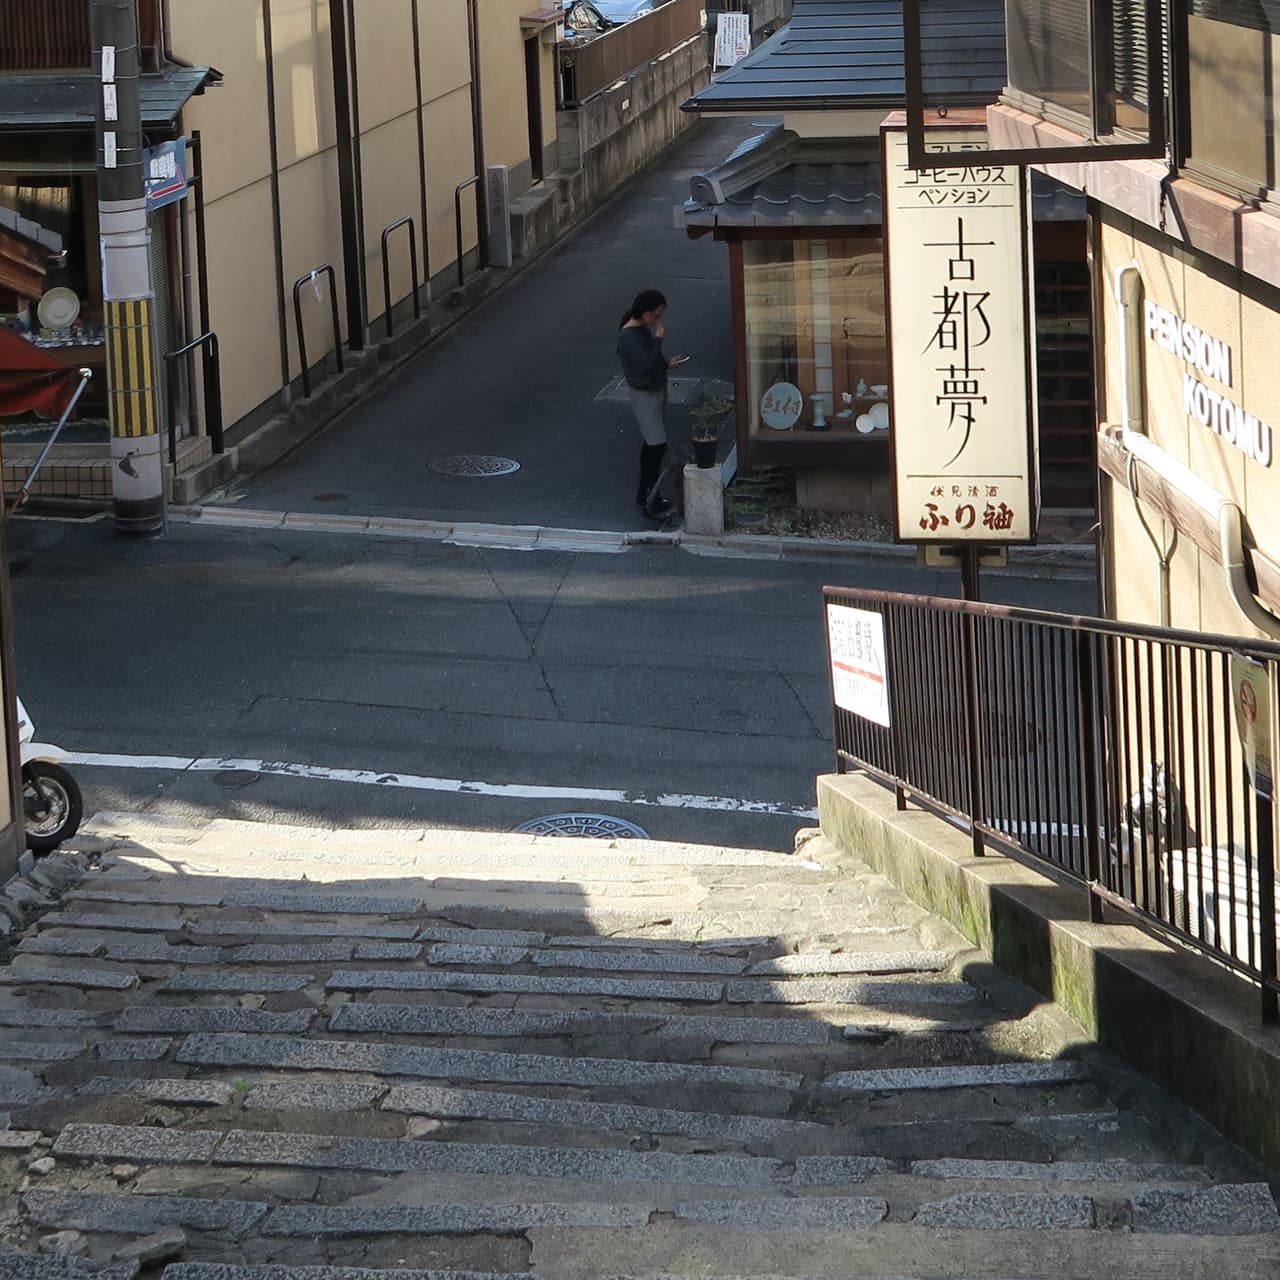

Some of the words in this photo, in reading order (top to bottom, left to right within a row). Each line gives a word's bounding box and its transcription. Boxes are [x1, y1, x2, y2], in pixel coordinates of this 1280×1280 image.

[904, 166, 1006, 185] コーヒーハウス
[918, 188, 990, 205] ペンション
[920, 216, 996, 470] 古都夢
[1145, 300, 1233, 389] PENSION
[1184, 373, 1272, 468] KOTOMU
[930, 484, 999, 498] 伏見清酒
[918, 501, 1014, 532] ふり袖
